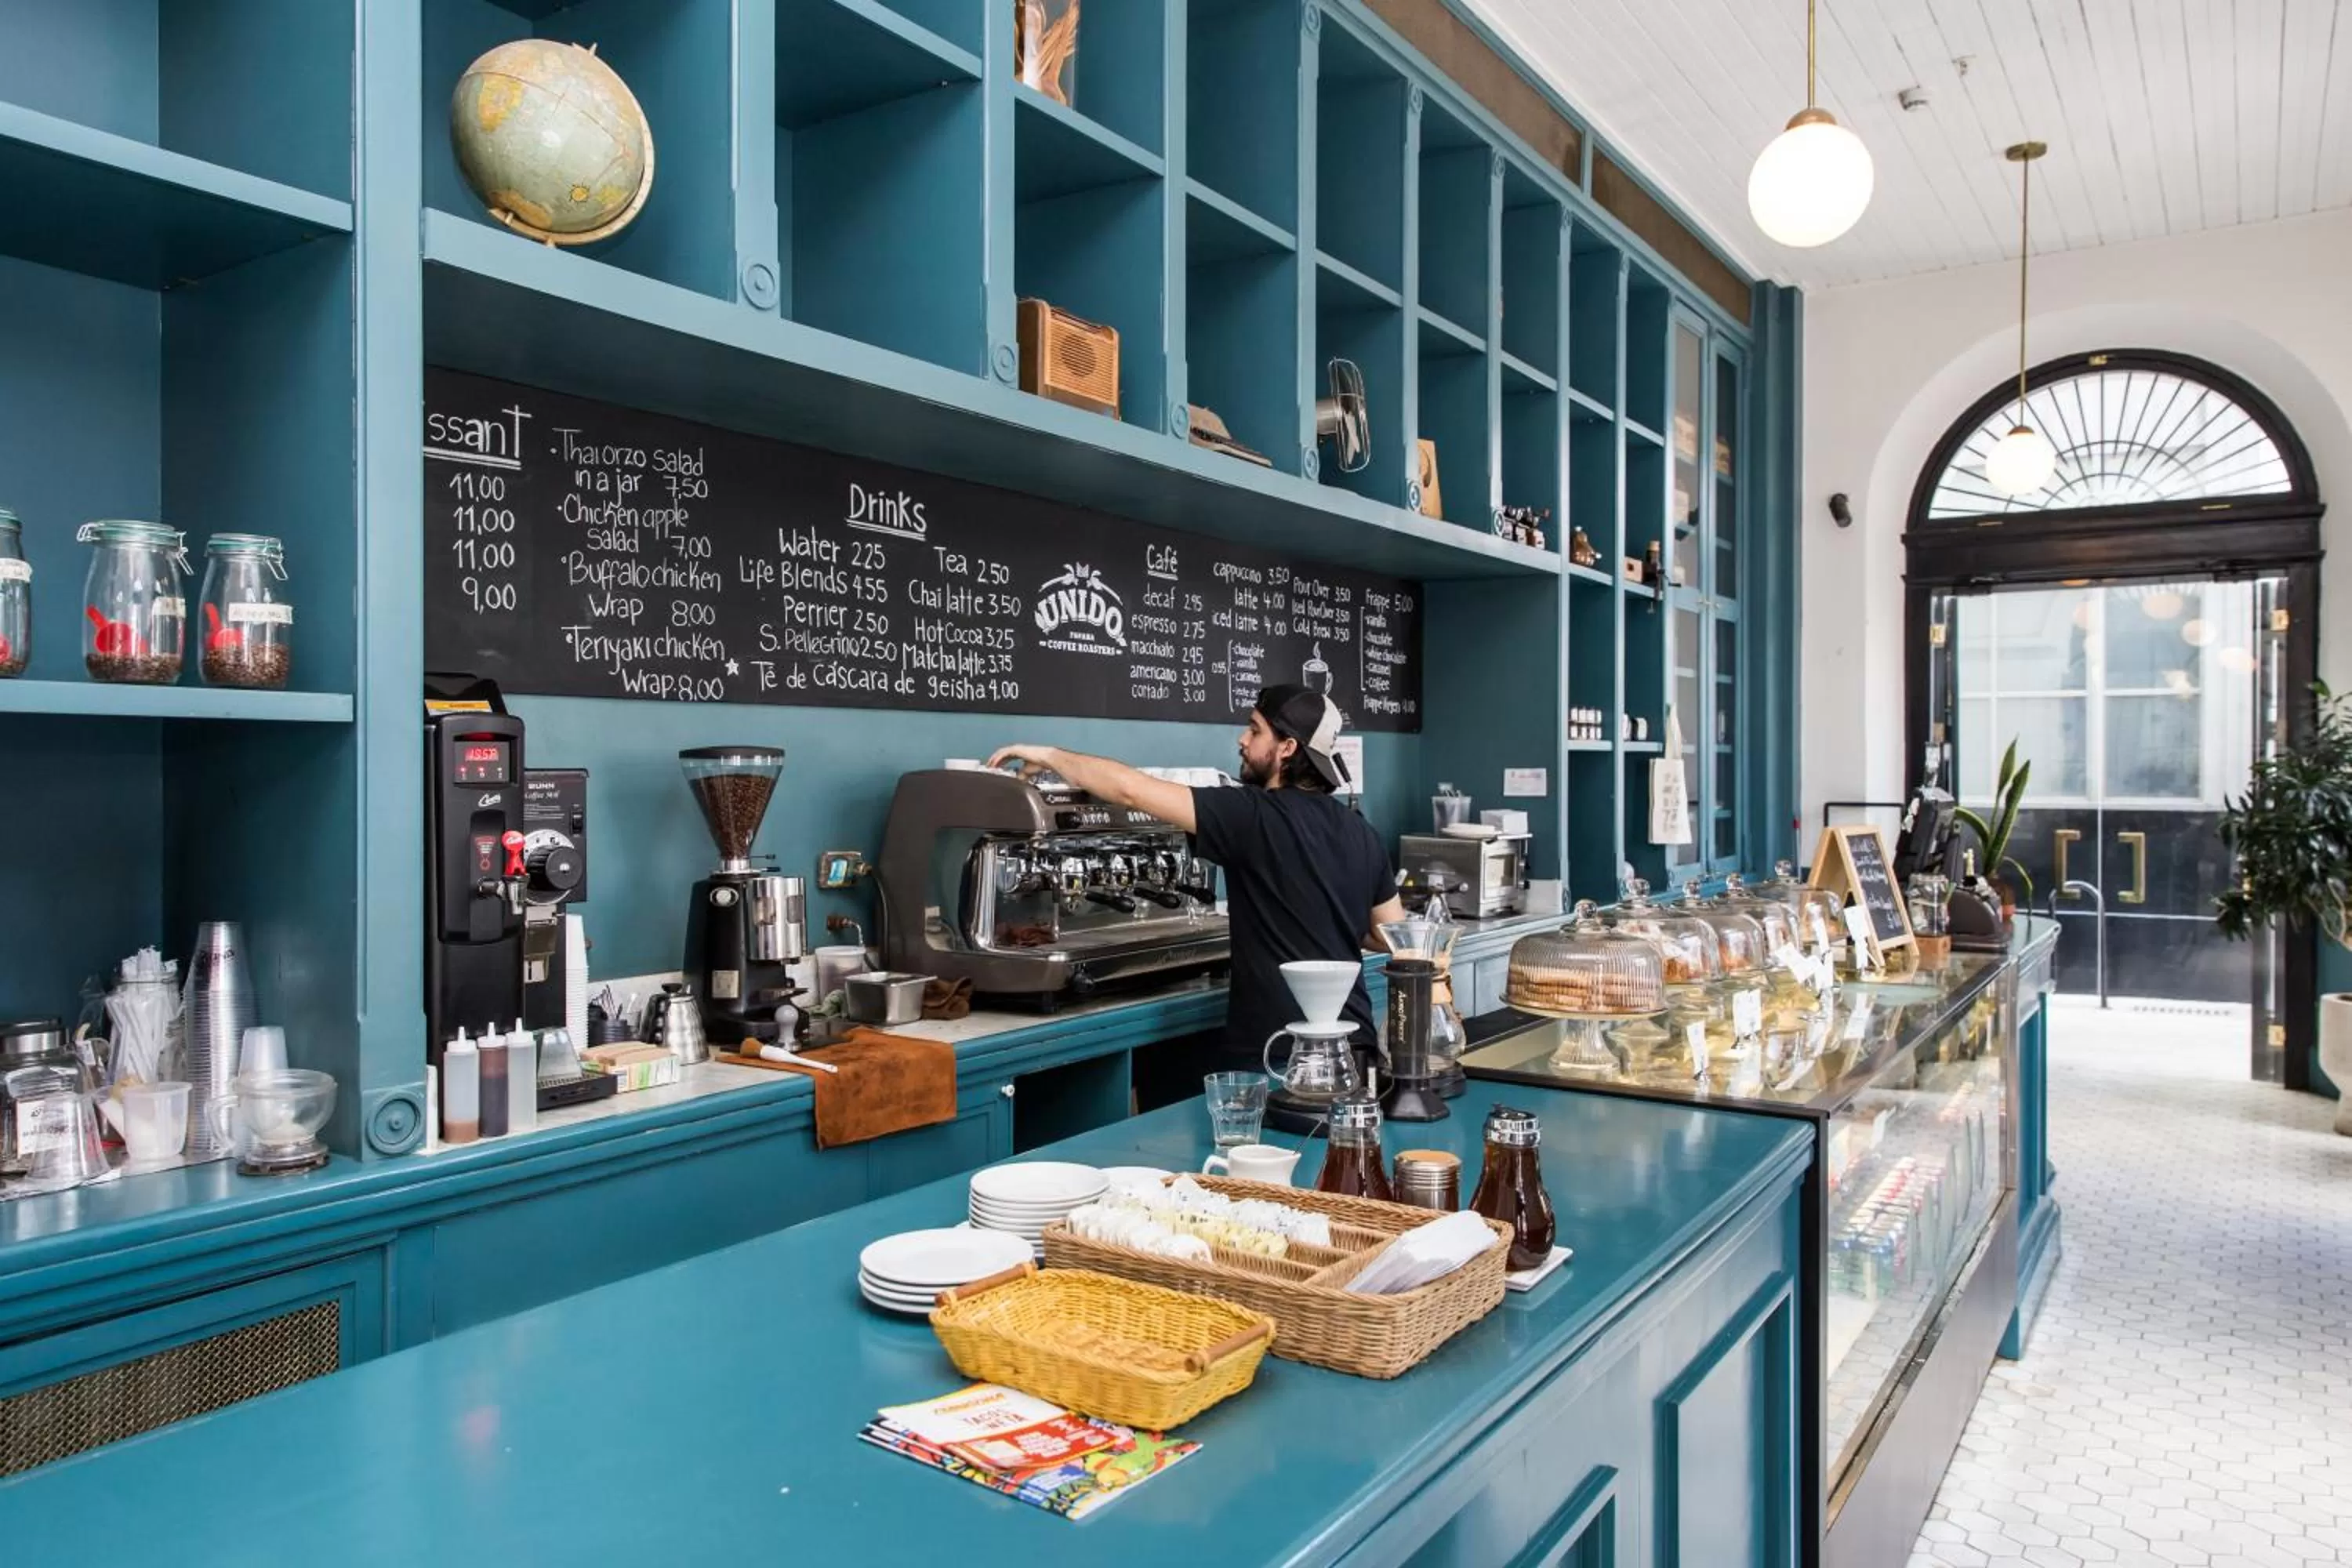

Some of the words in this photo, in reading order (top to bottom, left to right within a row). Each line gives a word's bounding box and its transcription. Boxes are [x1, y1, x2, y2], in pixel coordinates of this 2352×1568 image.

[596, 472, 609, 492] a
[614, 468, 643, 509] jar
[642, 499, 689, 539] apple
[850, 483, 927, 533] Drinks
[779, 525, 841, 563] Water
[933, 546, 968, 575] Tea
[568, 550, 649, 589] Buffalo
[739, 554, 775, 590] Life
[781, 561, 848, 595] Blends
[783, 595, 848, 628] Perrier
[908, 579, 942, 608] Chai
[946, 583, 983, 615] latte
[1036, 588, 1123, 638] UNIDO
[759, 623, 782, 652] S.
[914, 615, 945, 644] Hot
[1131, 613, 1177, 635] espresso
[902, 641, 956, 673] Matcha
[1078, 642, 1116, 656] ROASTERS
[786, 662, 808, 690] de
[894, 670, 916, 695] de
[927, 675, 986, 702] geisha
[1131, 682, 1171, 700] cortado
